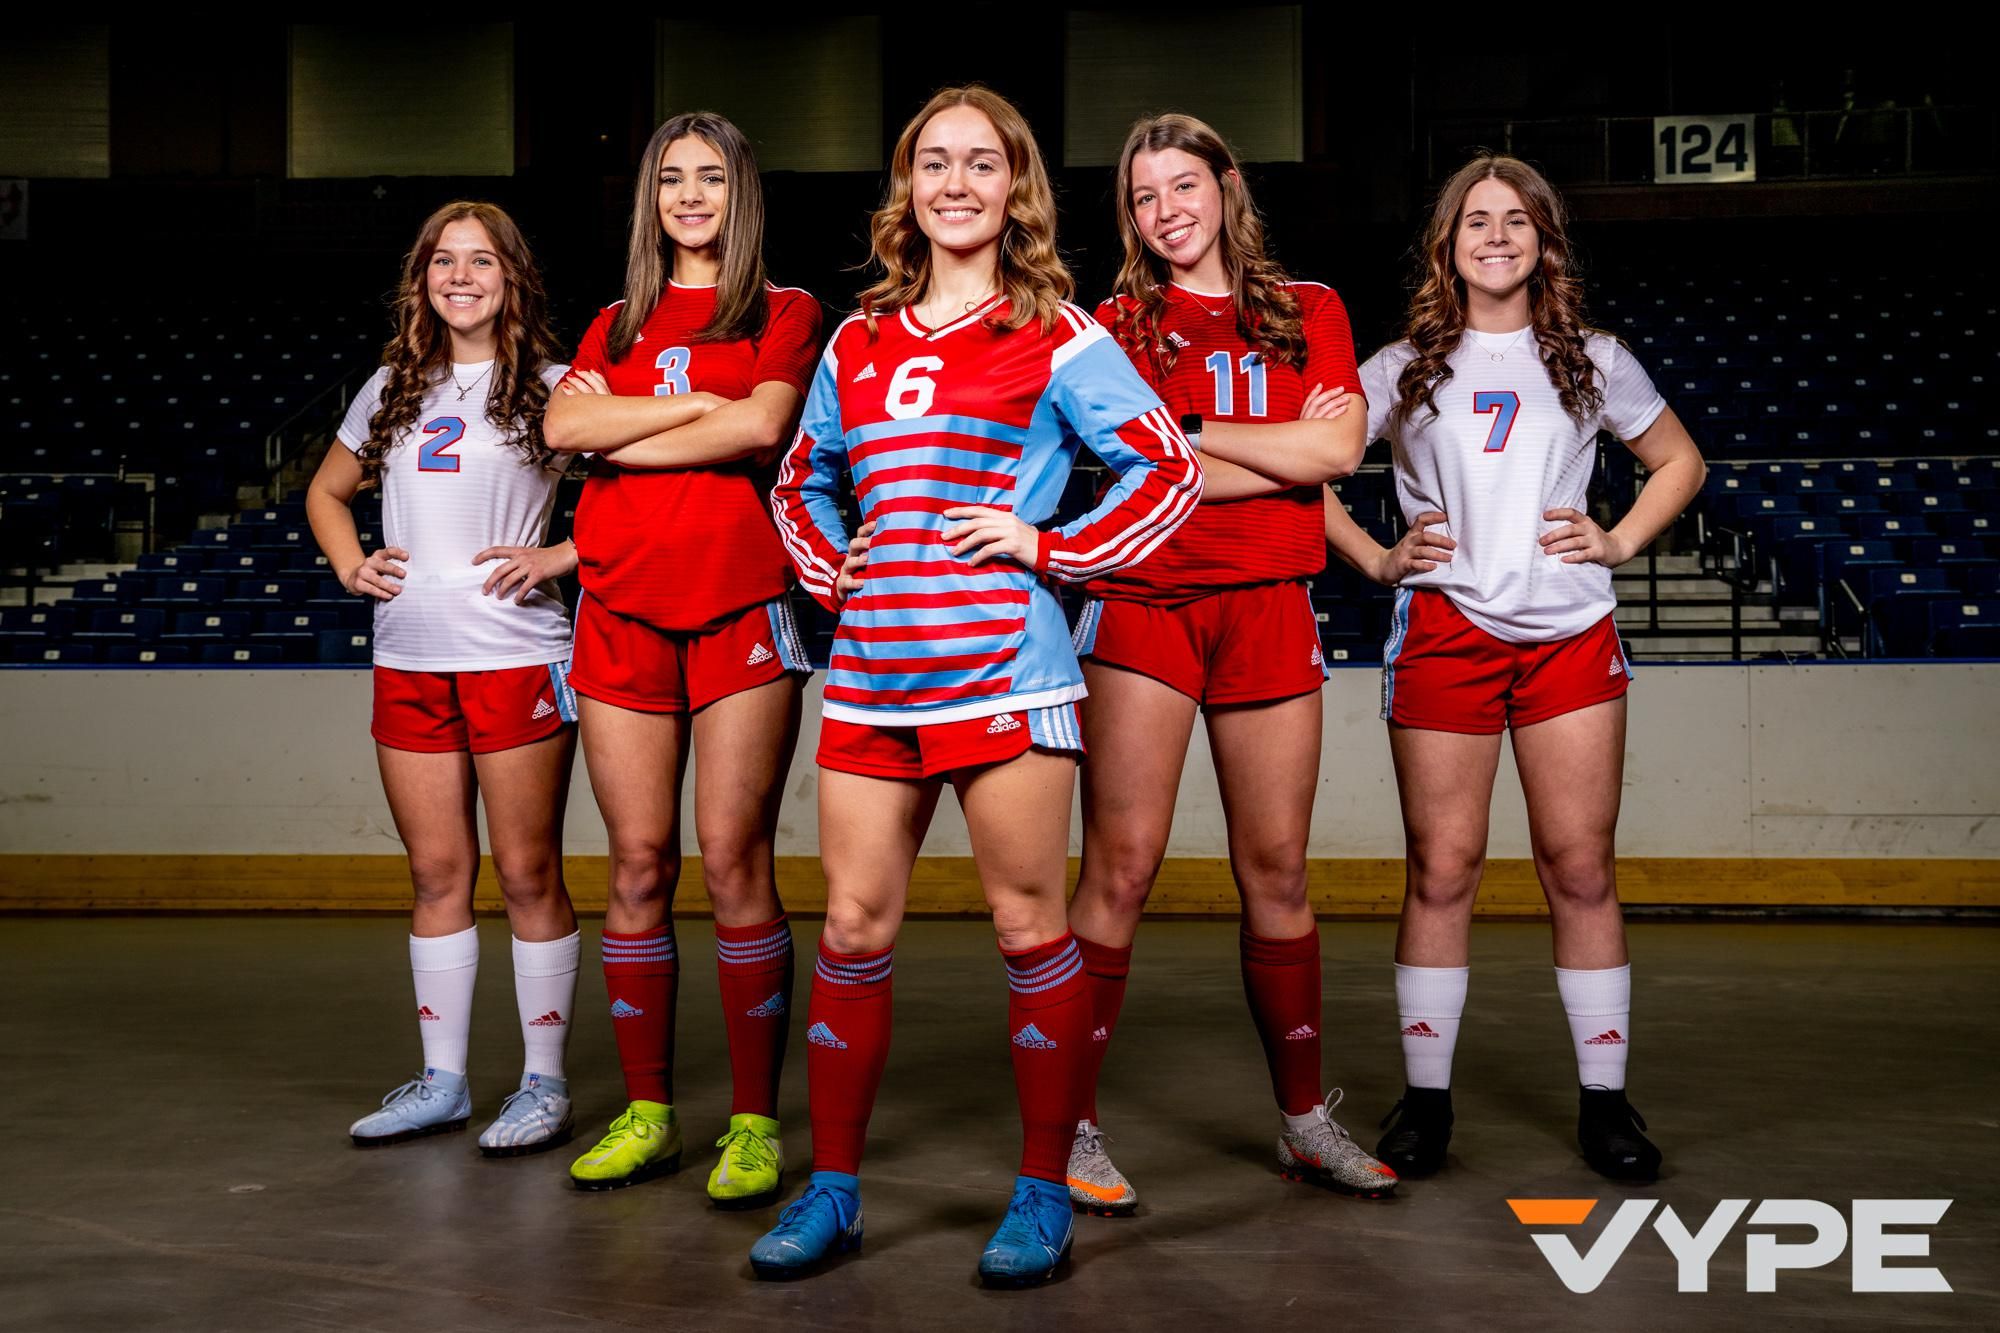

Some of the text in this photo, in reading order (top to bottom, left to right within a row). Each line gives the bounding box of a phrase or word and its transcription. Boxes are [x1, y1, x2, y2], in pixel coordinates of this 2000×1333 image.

[1659, 123, 1748, 174] 124
[654, 346, 691, 397] 3
[885, 355, 945, 421] 6
[1205, 350, 1267, 416] 11
[1473, 391, 1521, 453] 7
[418, 416, 466, 473] 2
[747, 651, 773, 666] adidas
[531, 705, 555, 720] adidas
[986, 720, 1021, 734] adidas
[746, 1007, 785, 1018] adida
[1012, 1035, 1057, 1050] adidas
[1400, 1030, 1439, 1038] adidas
